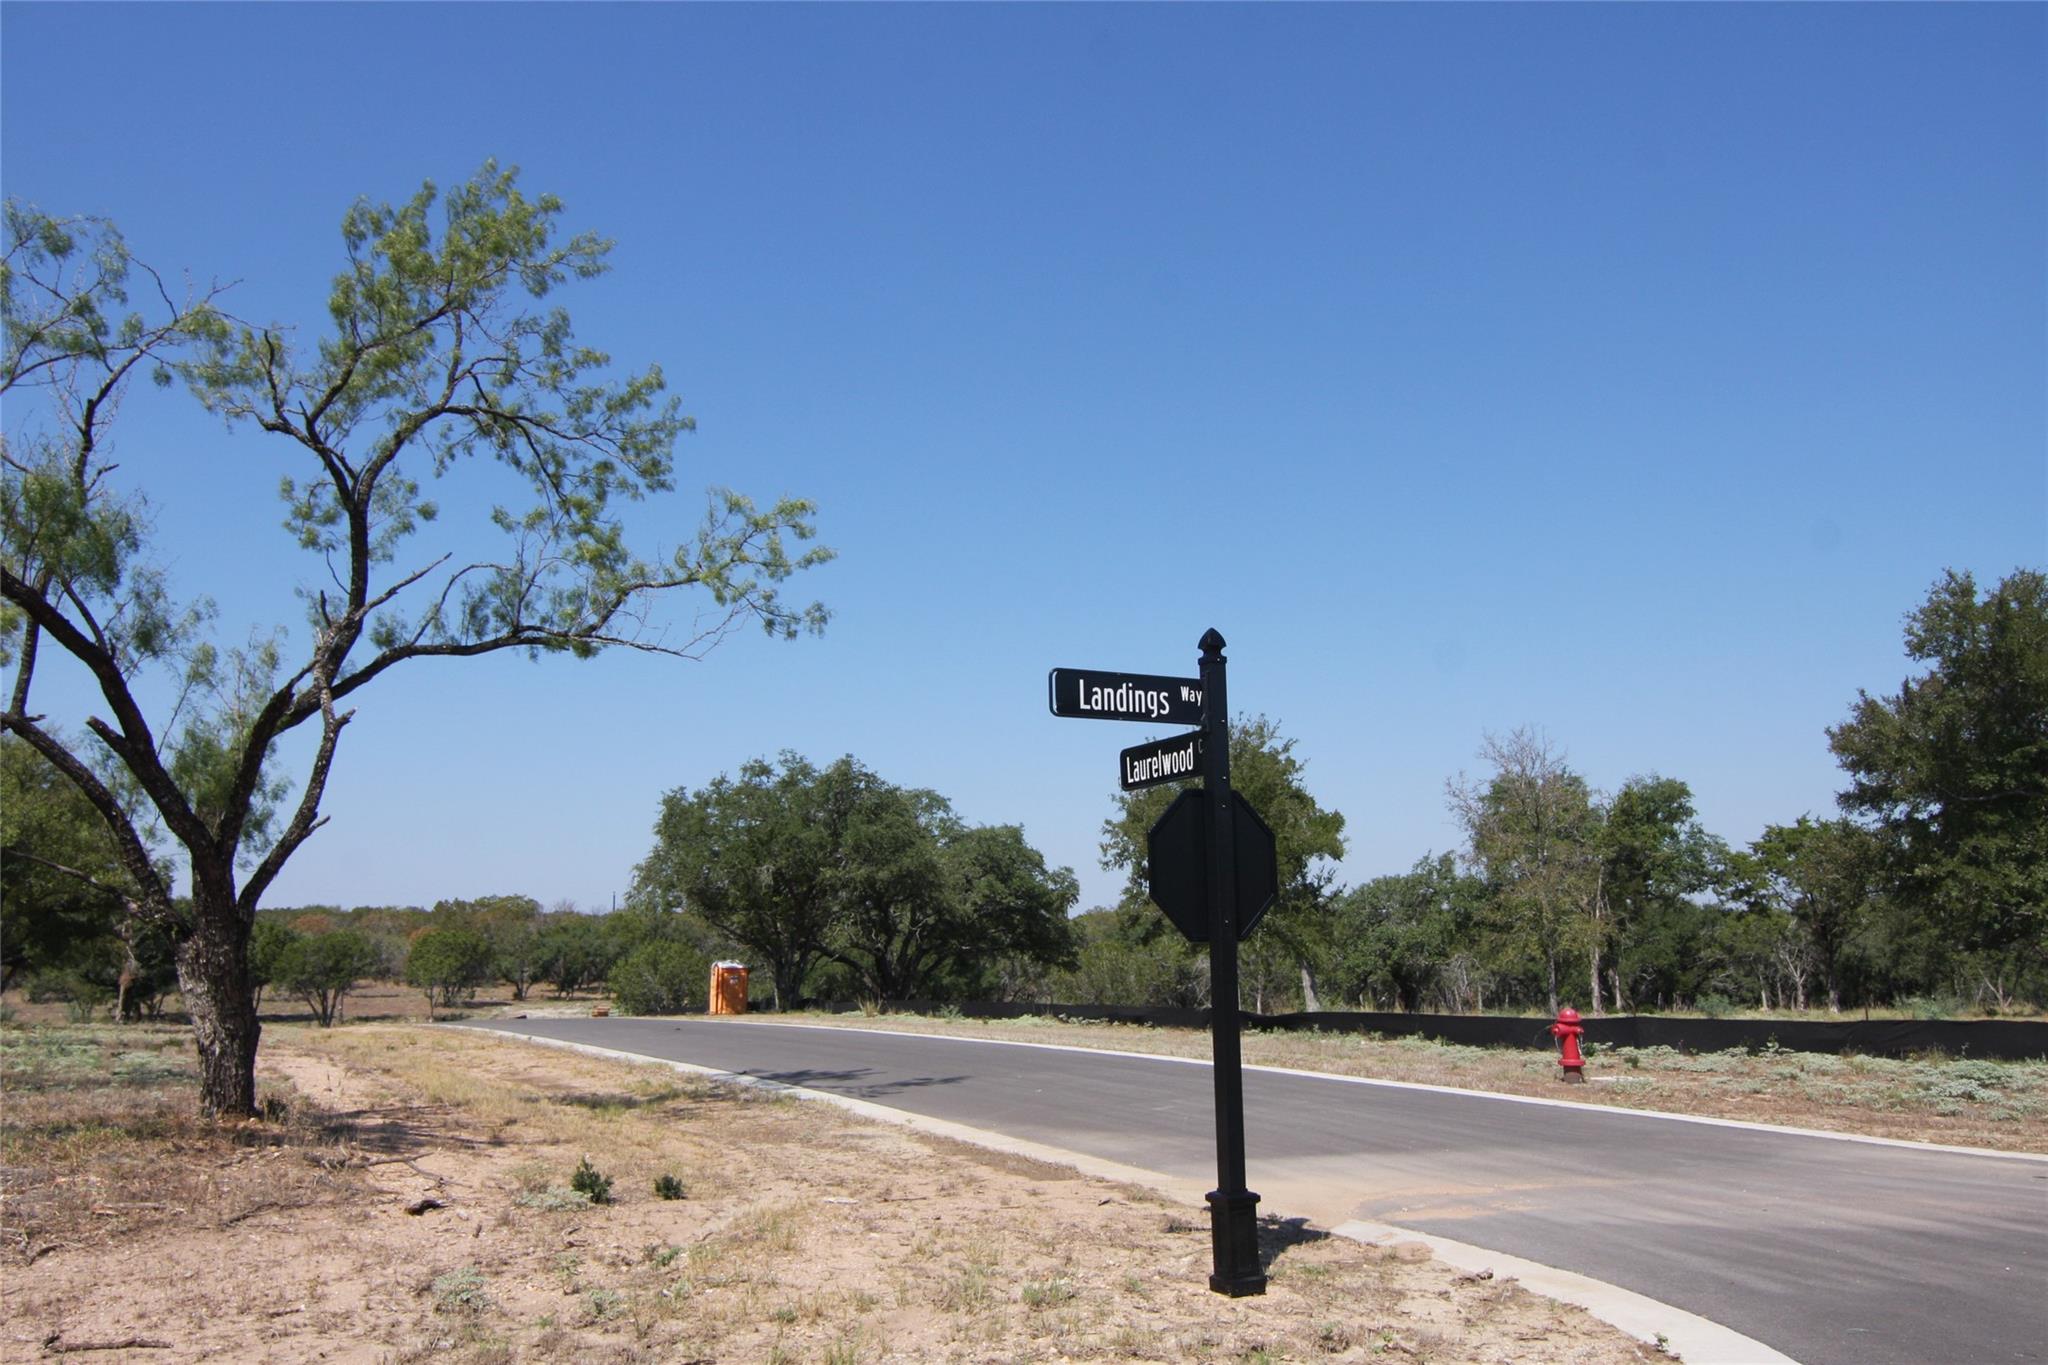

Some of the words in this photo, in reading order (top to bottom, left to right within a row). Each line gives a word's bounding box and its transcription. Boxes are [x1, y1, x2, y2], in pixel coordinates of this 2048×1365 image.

[1079, 679, 1170, 718] Landings
[1180, 686, 1202, 706] Way
[1126, 742, 1193, 783] Laurelwood
